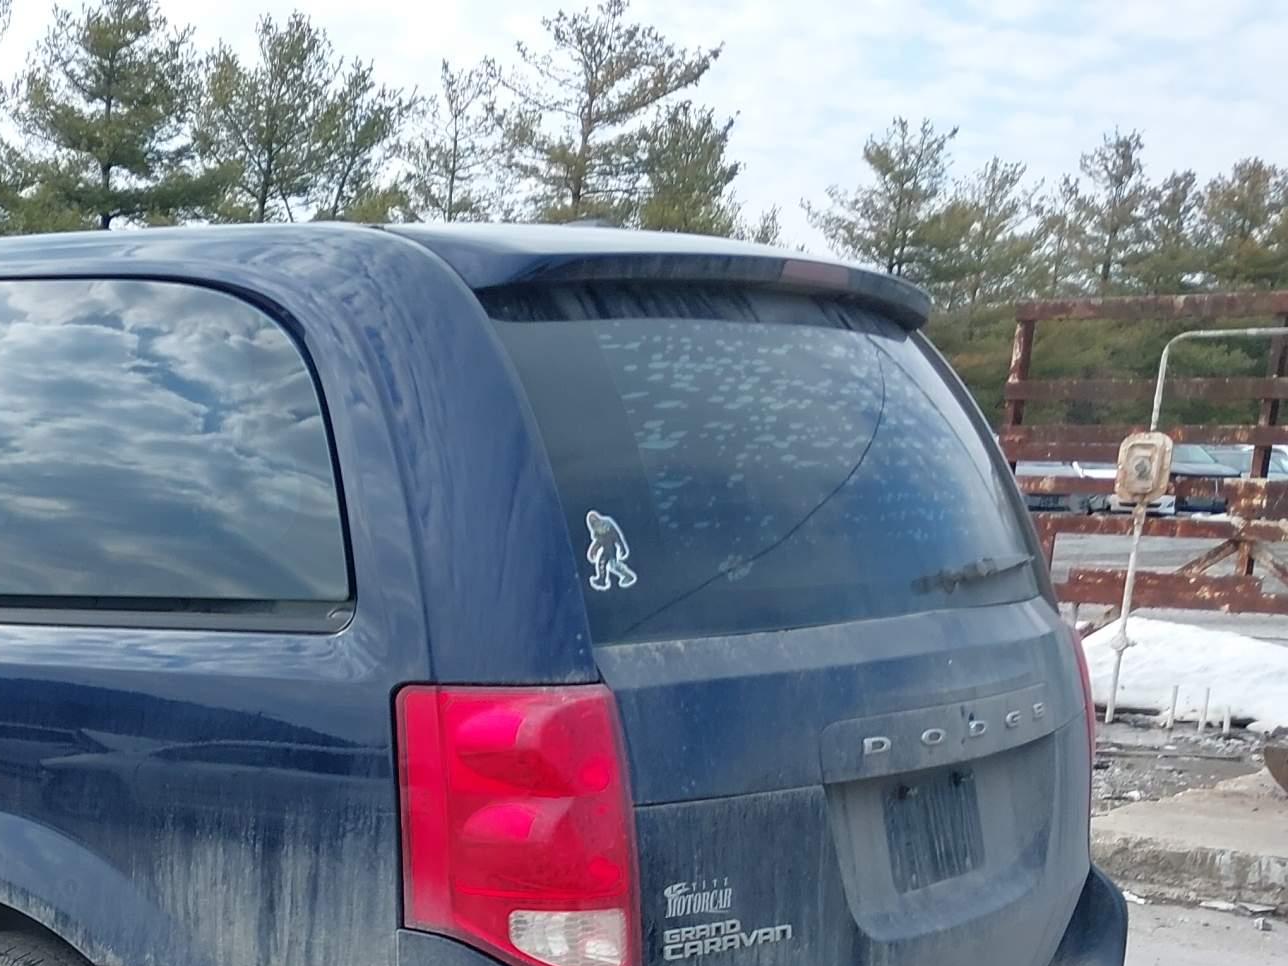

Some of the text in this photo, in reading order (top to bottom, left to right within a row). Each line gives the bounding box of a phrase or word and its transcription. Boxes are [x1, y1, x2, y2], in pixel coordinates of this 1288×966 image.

[863, 702, 1045, 755] DODGE
[663, 918, 742, 944] GRAND
[663, 924, 793, 961] CARAVAN
